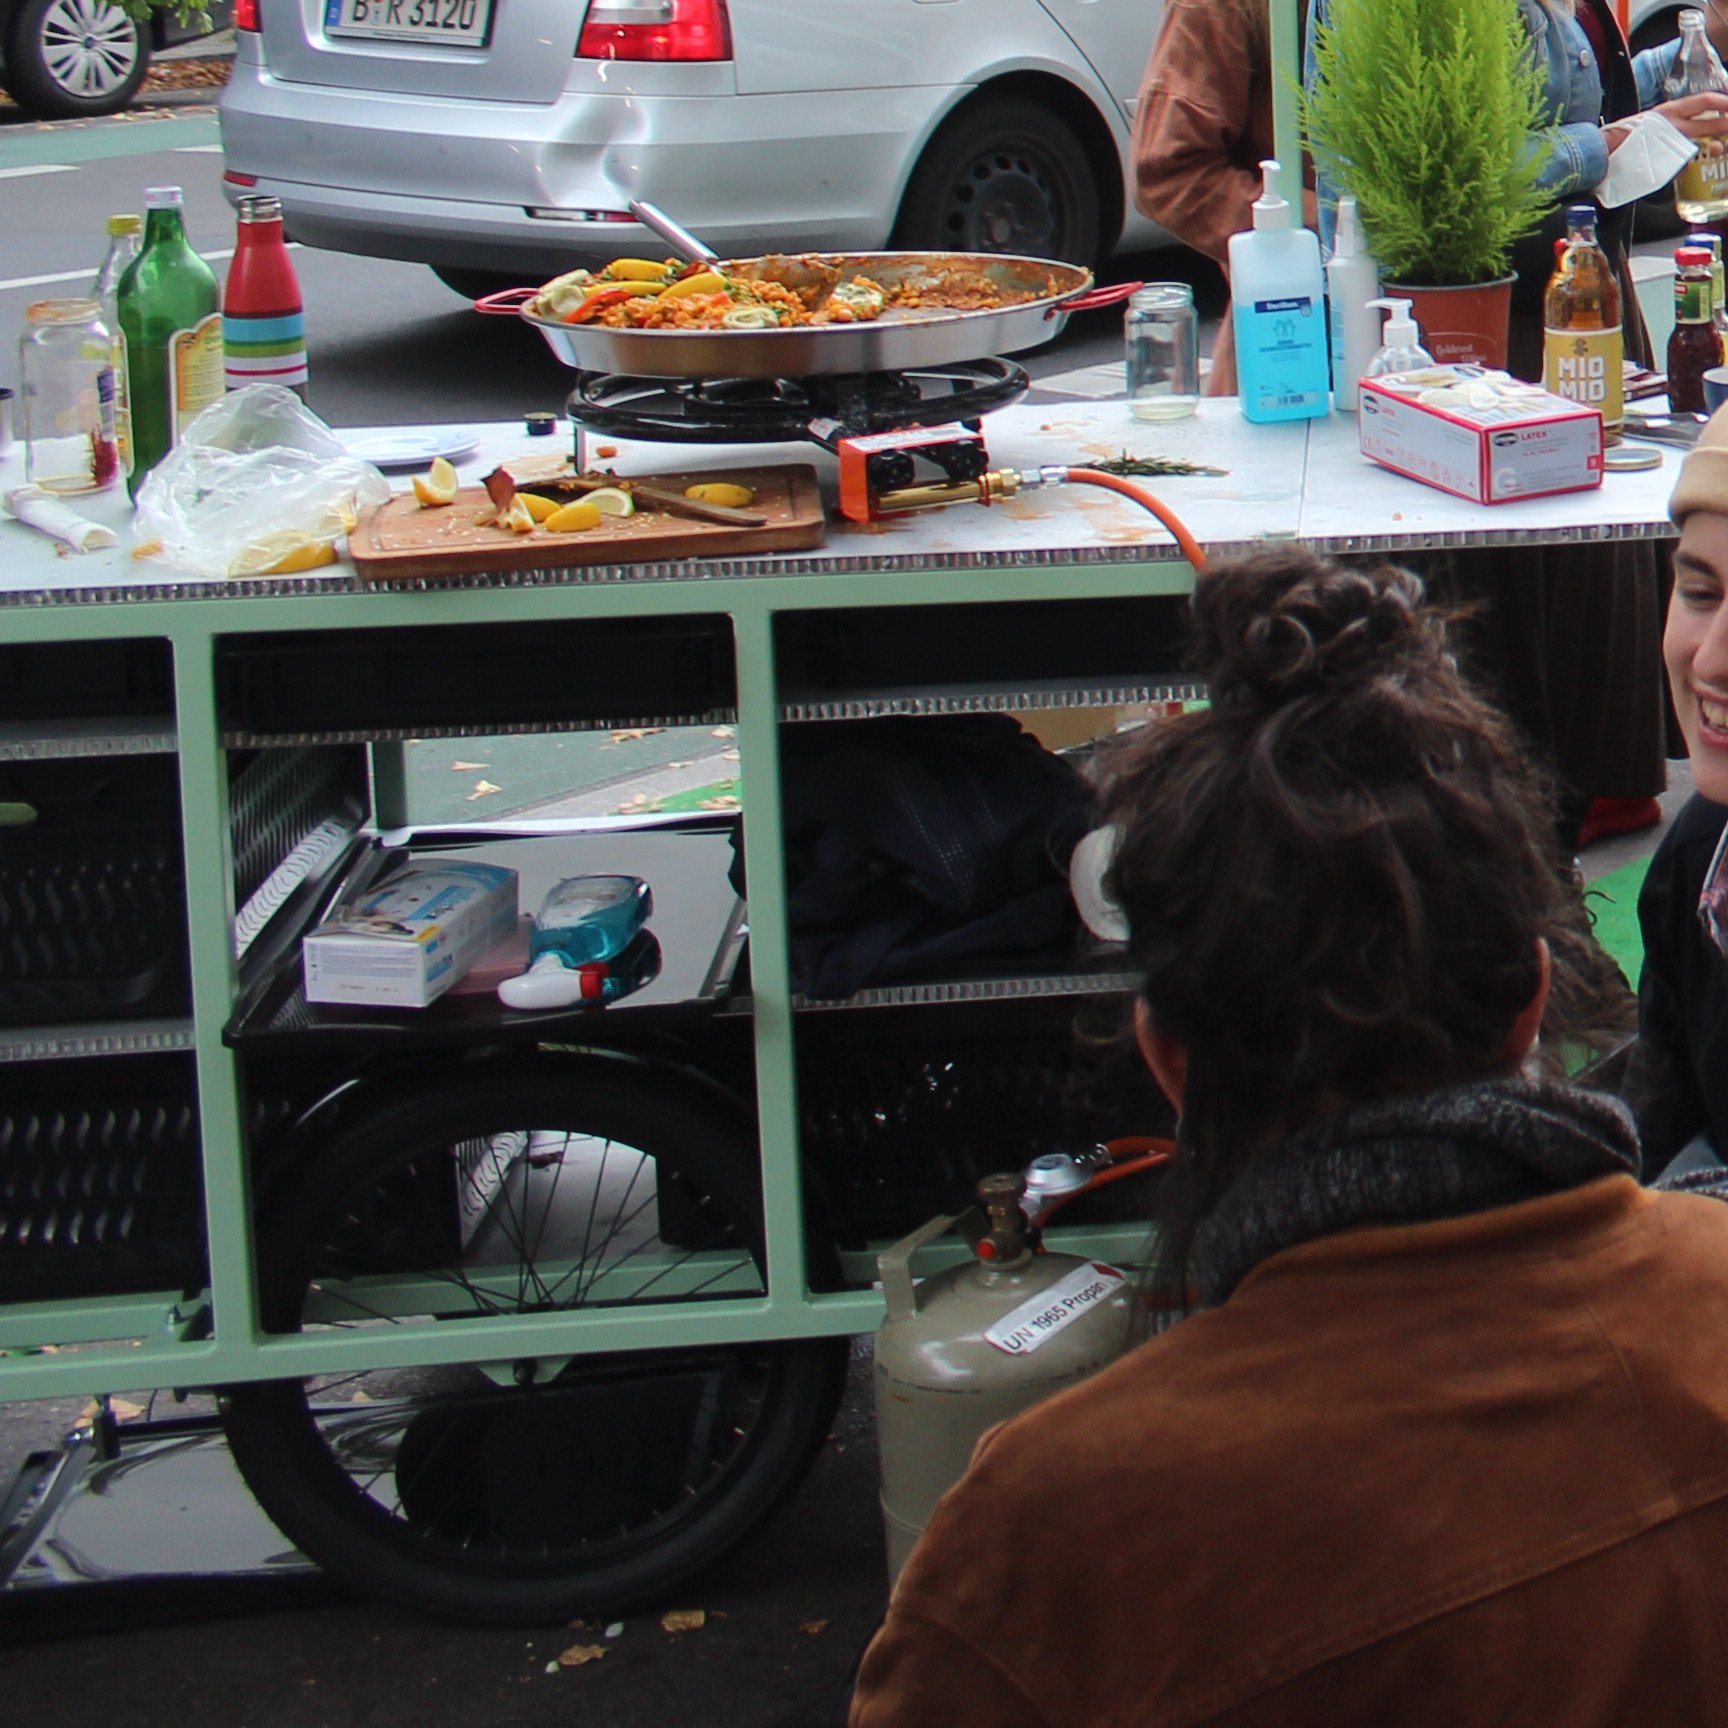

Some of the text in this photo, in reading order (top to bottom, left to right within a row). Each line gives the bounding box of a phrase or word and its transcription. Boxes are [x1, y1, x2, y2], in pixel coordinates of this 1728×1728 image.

[1558, 355, 1605, 379] MIO
[1558, 378, 1606, 403] MIO
[1521, 431, 1548, 442] LATEX
[1003, 1281, 1109, 1350] UN 1965 Propan
